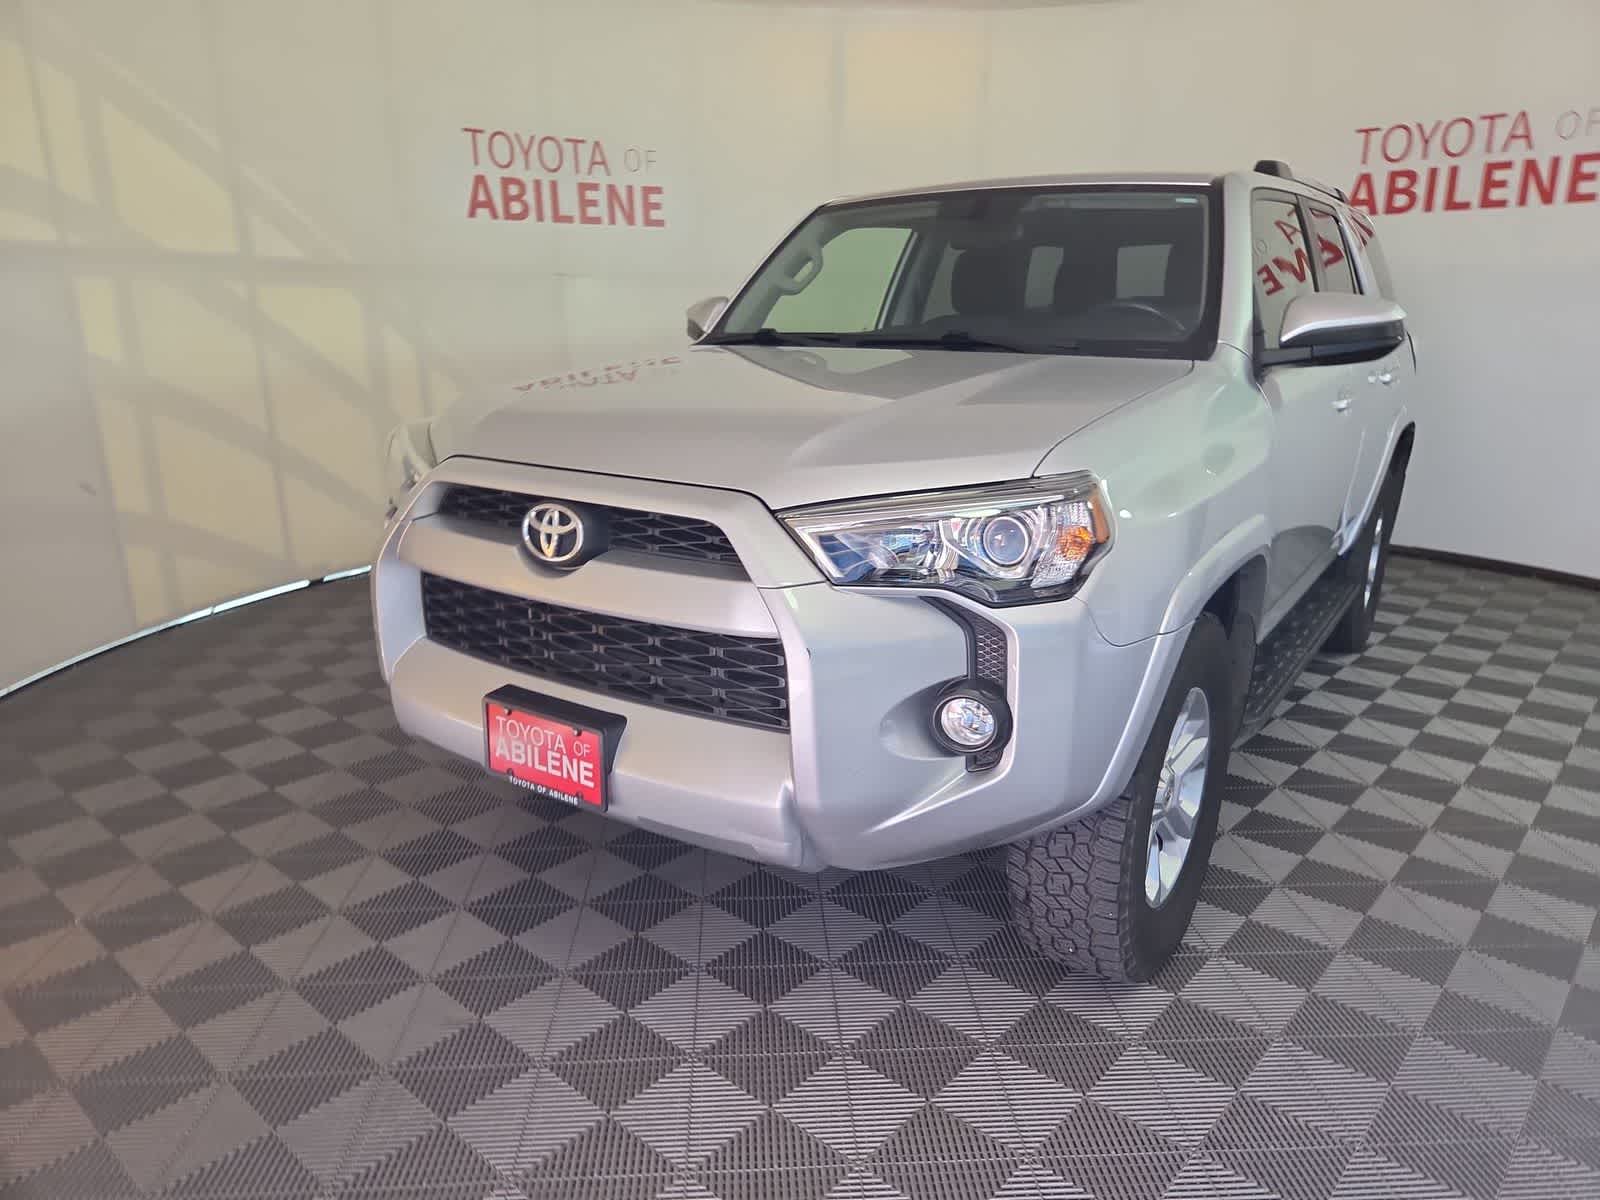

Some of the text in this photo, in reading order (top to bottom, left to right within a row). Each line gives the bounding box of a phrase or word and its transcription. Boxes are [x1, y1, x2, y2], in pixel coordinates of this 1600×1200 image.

[462, 127, 657, 177] TOYOTA OF
[1355, 110, 1534, 165] TOYOTA
[466, 173, 666, 228] ABILENE
[1349, 152, 1600, 216] ABILENE
[495, 716, 592, 757] TOYOTA OF
[495, 736, 595, 788] ABILENE
[509, 775, 578, 806] TOYOTA OF ABILENE
